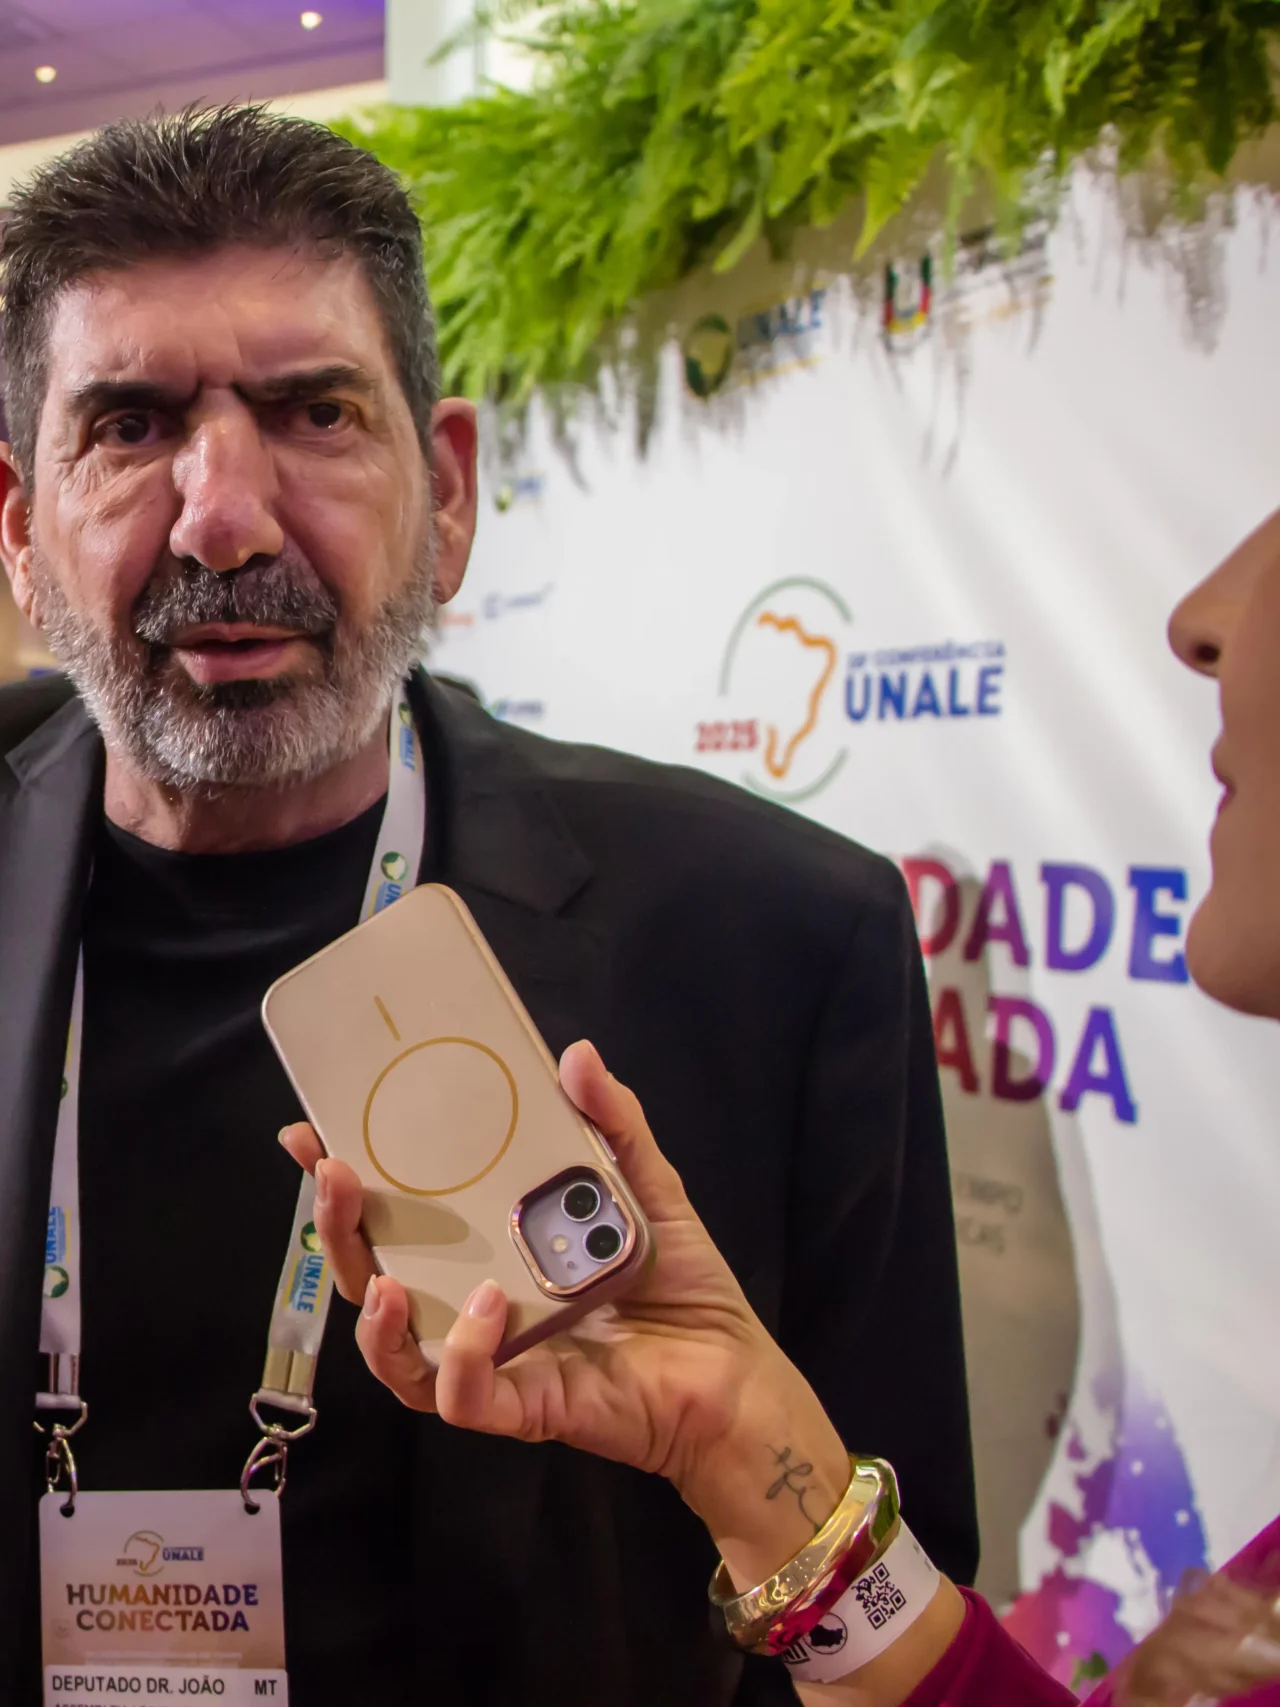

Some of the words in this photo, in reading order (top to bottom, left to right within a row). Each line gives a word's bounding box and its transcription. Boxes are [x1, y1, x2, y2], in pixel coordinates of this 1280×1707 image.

[846, 666, 1005, 722] UNALE
[902, 856, 1189, 985] DADE
[933, 986, 1138, 1126] ADA
[297, 1255, 325, 1314] UNALE
[162, 1548, 205, 1562] UNALE
[66, 1583, 259, 1606] HUMANIDADE
[76, 1609, 250, 1632] CONECTADA
[52, 1675, 141, 1694] DEPUTADO
[146, 1677, 173, 1694] DR.
[179, 1675, 225, 1695] JOÃO
[254, 1679, 278, 1696] MT
